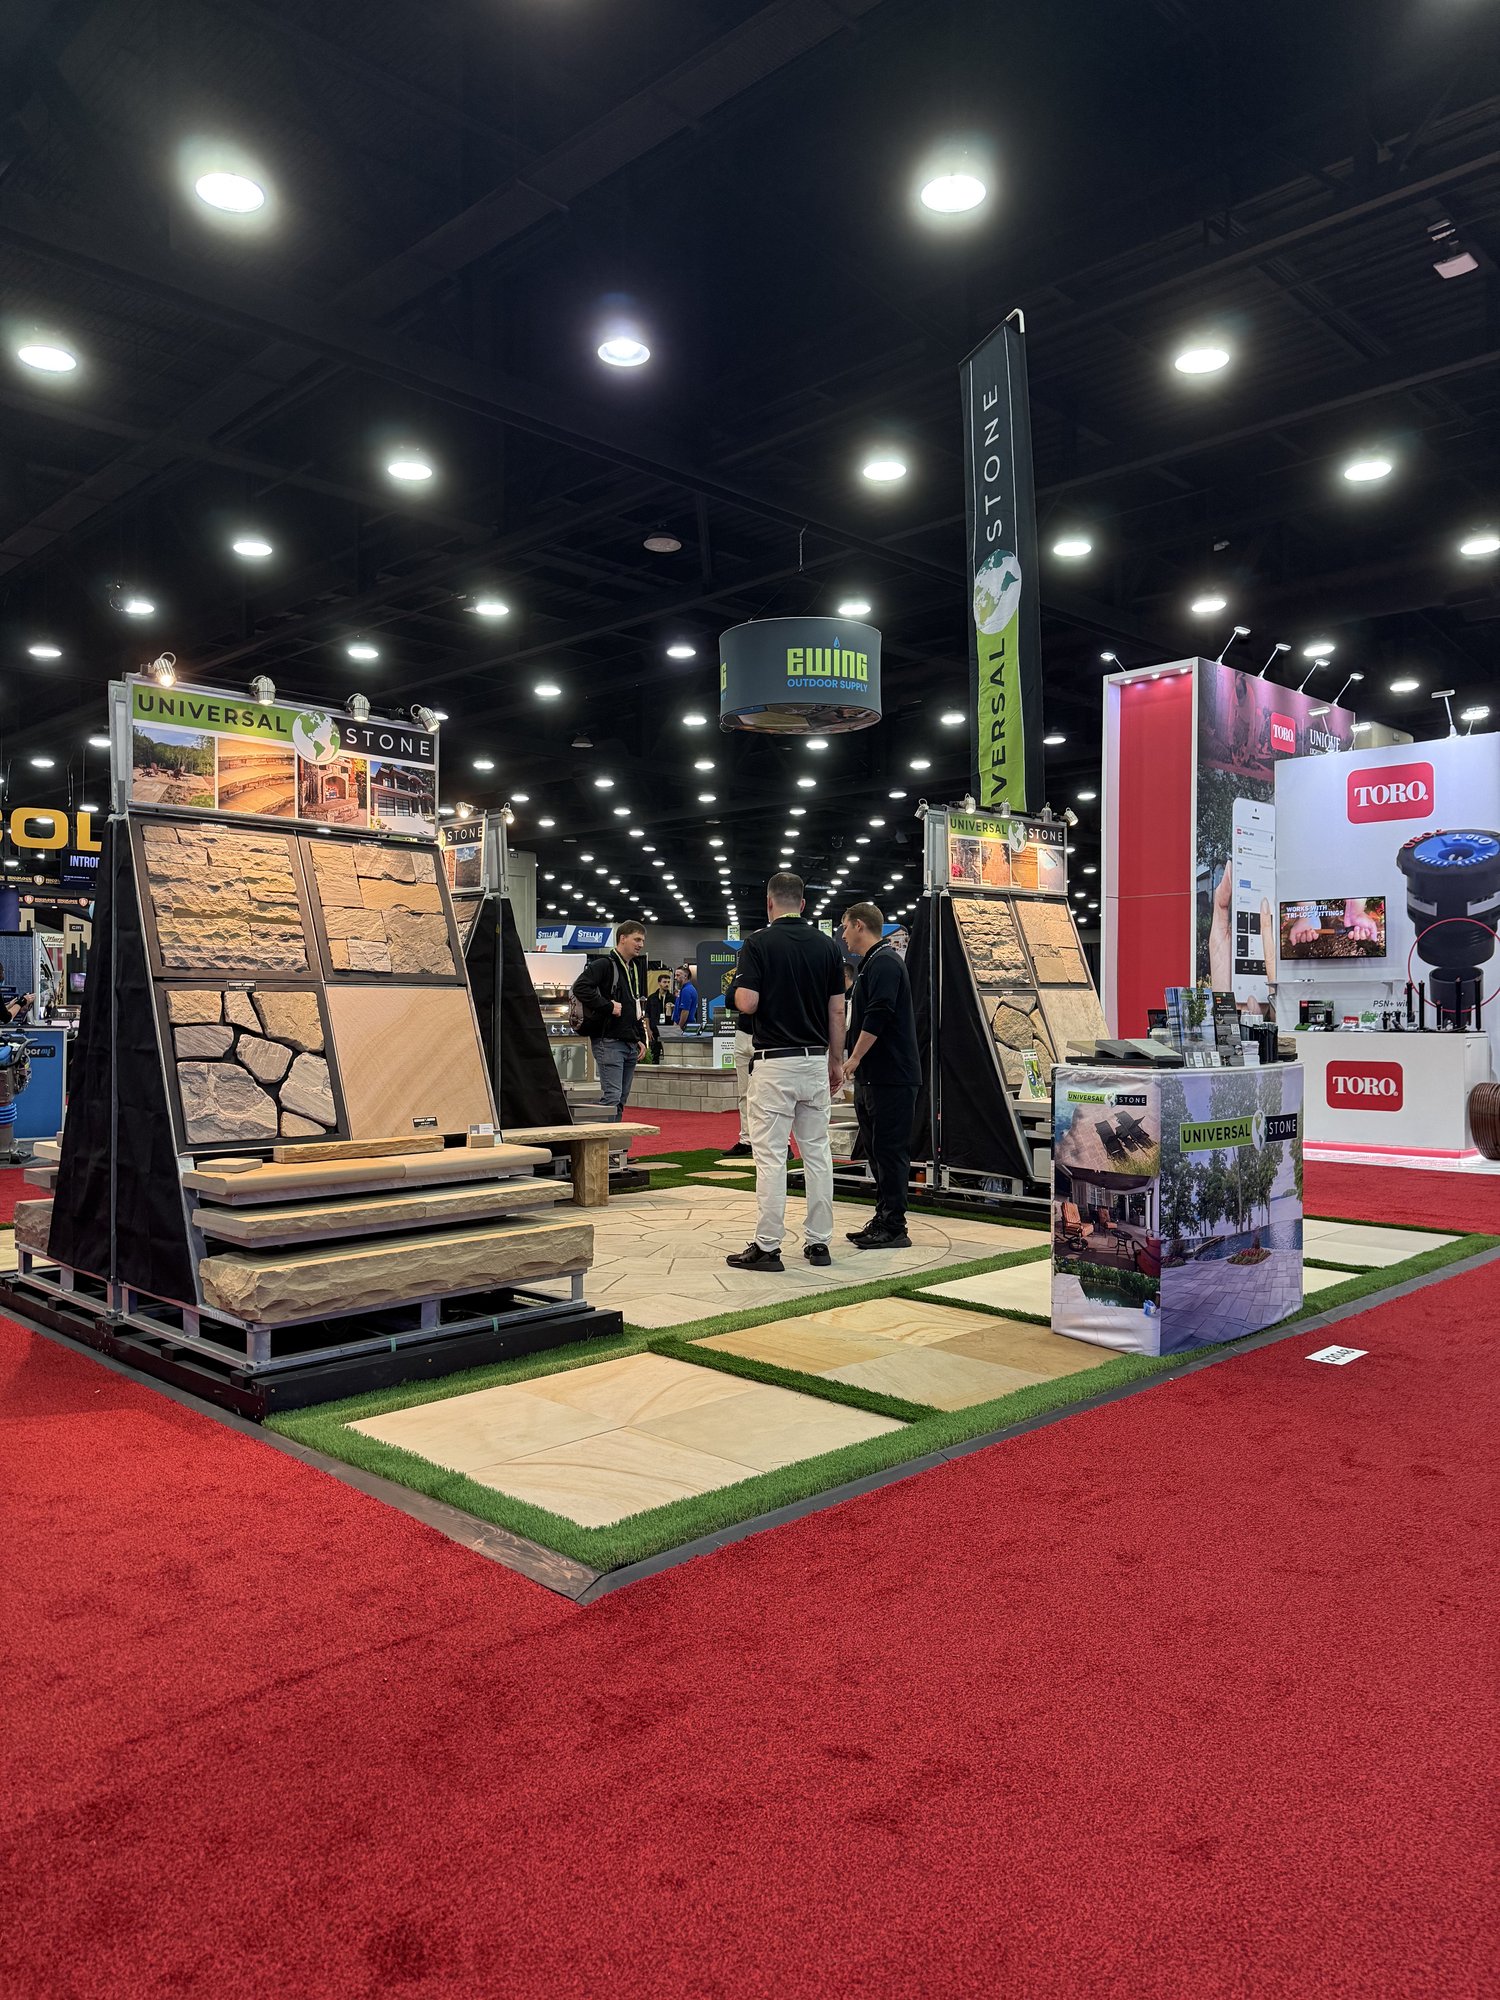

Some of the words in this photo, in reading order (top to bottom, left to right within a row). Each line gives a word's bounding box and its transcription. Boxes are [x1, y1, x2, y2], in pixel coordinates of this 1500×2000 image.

[983, 385, 1002, 542] STONE
[787, 678, 838, 689] OUTDOOR
[839, 680, 868, 693] SUPPLY
[138, 693, 288, 733] UNIVERSAL
[346, 727, 430, 757] STONE
[989, 638, 1008, 806] VERSAL
[1354, 780, 1428, 807] TORO
[447, 826, 483, 842] STONE
[951, 818, 1007, 834] UNIVERSAL
[1028, 827, 1063, 842] STONE
[537, 931, 559, 939] STELLAR
[577, 929, 604, 940] STELLAR
[1333, 1076, 1398, 1096] TORO
[1068, 1093, 1104, 1102] UNIVERSAL
[1183, 1123, 1251, 1143] UNIVERSAL
[1268, 1119, 1297, 1135] STONE
